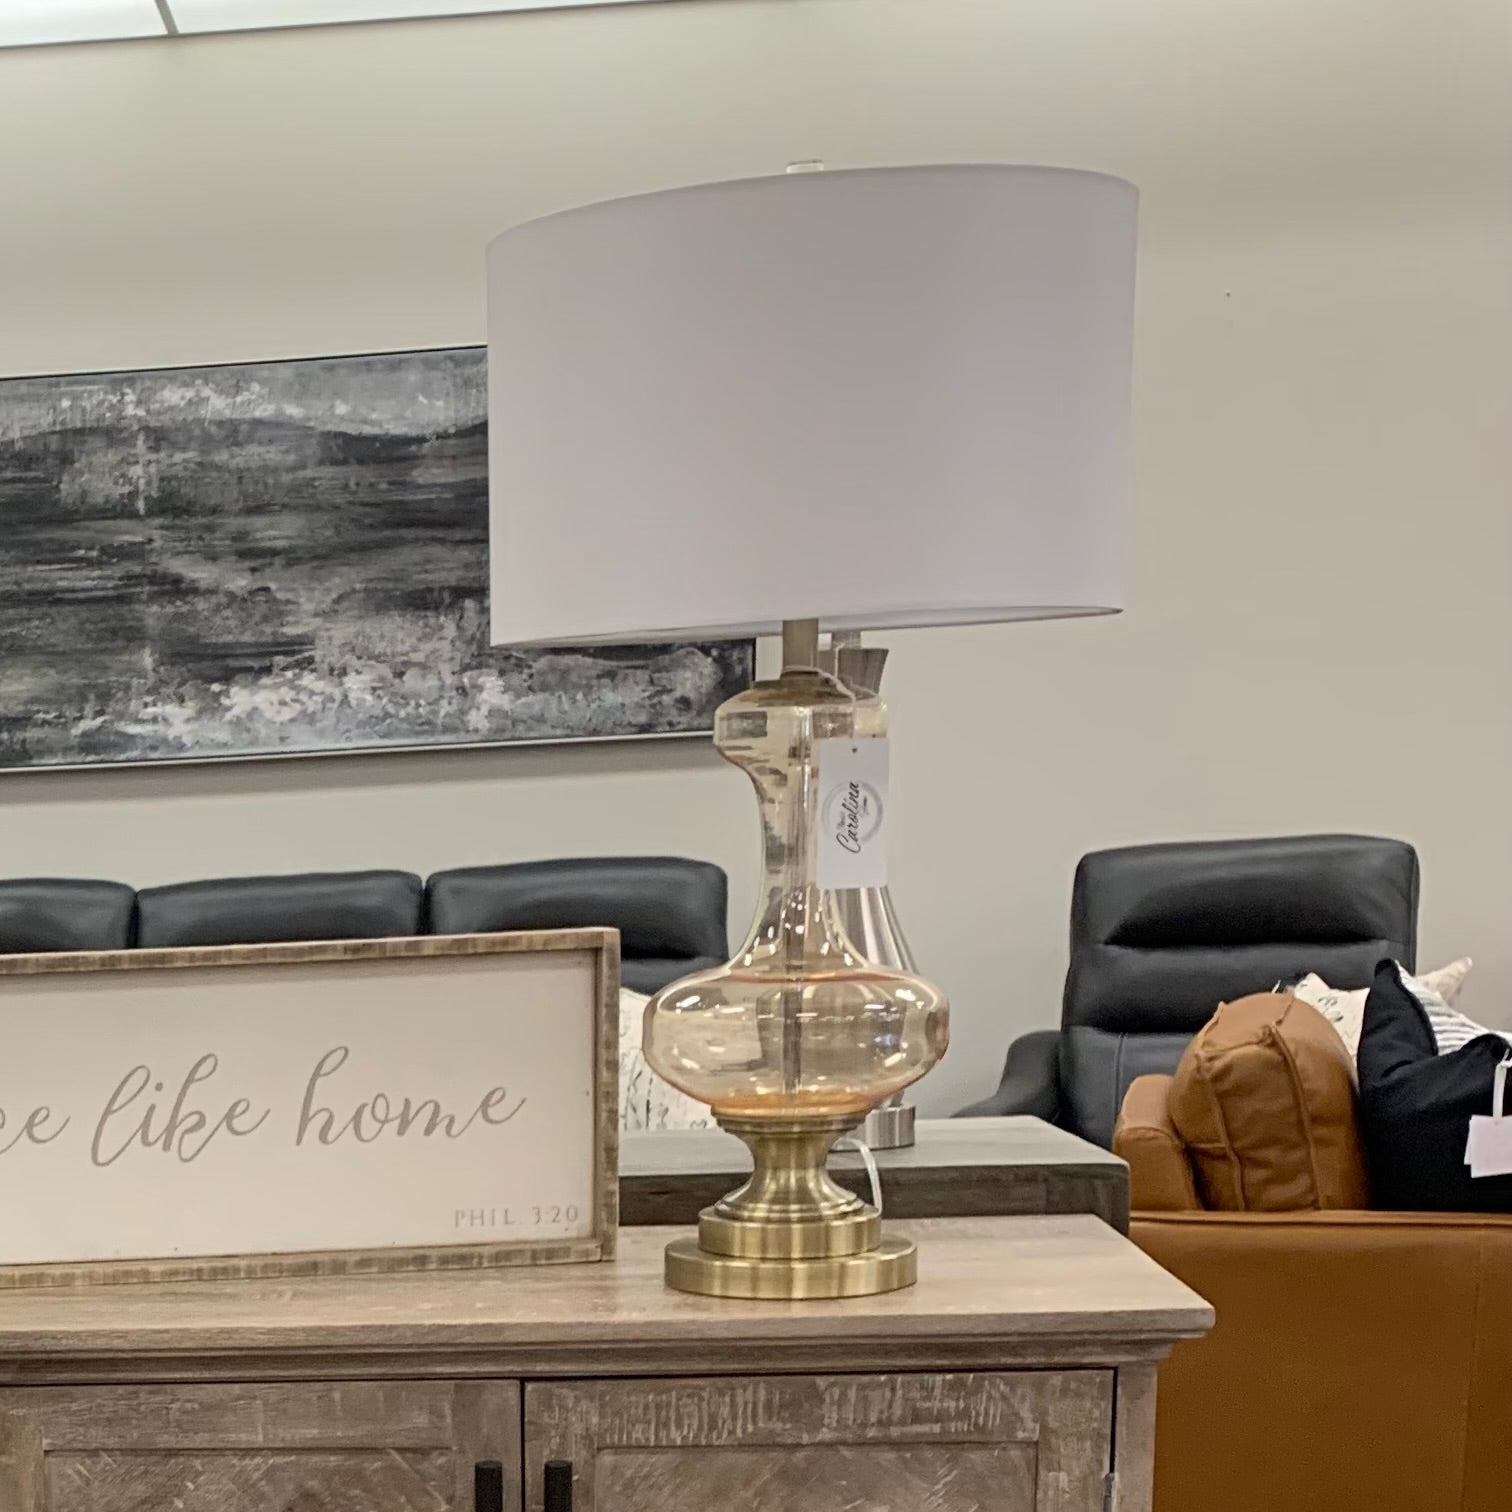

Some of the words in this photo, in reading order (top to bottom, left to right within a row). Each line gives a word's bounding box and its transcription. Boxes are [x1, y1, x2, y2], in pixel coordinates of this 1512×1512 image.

[835, 780, 862, 854] Carolina
[90, 1053, 271, 1167] like
[295, 1046, 527, 1146] home
